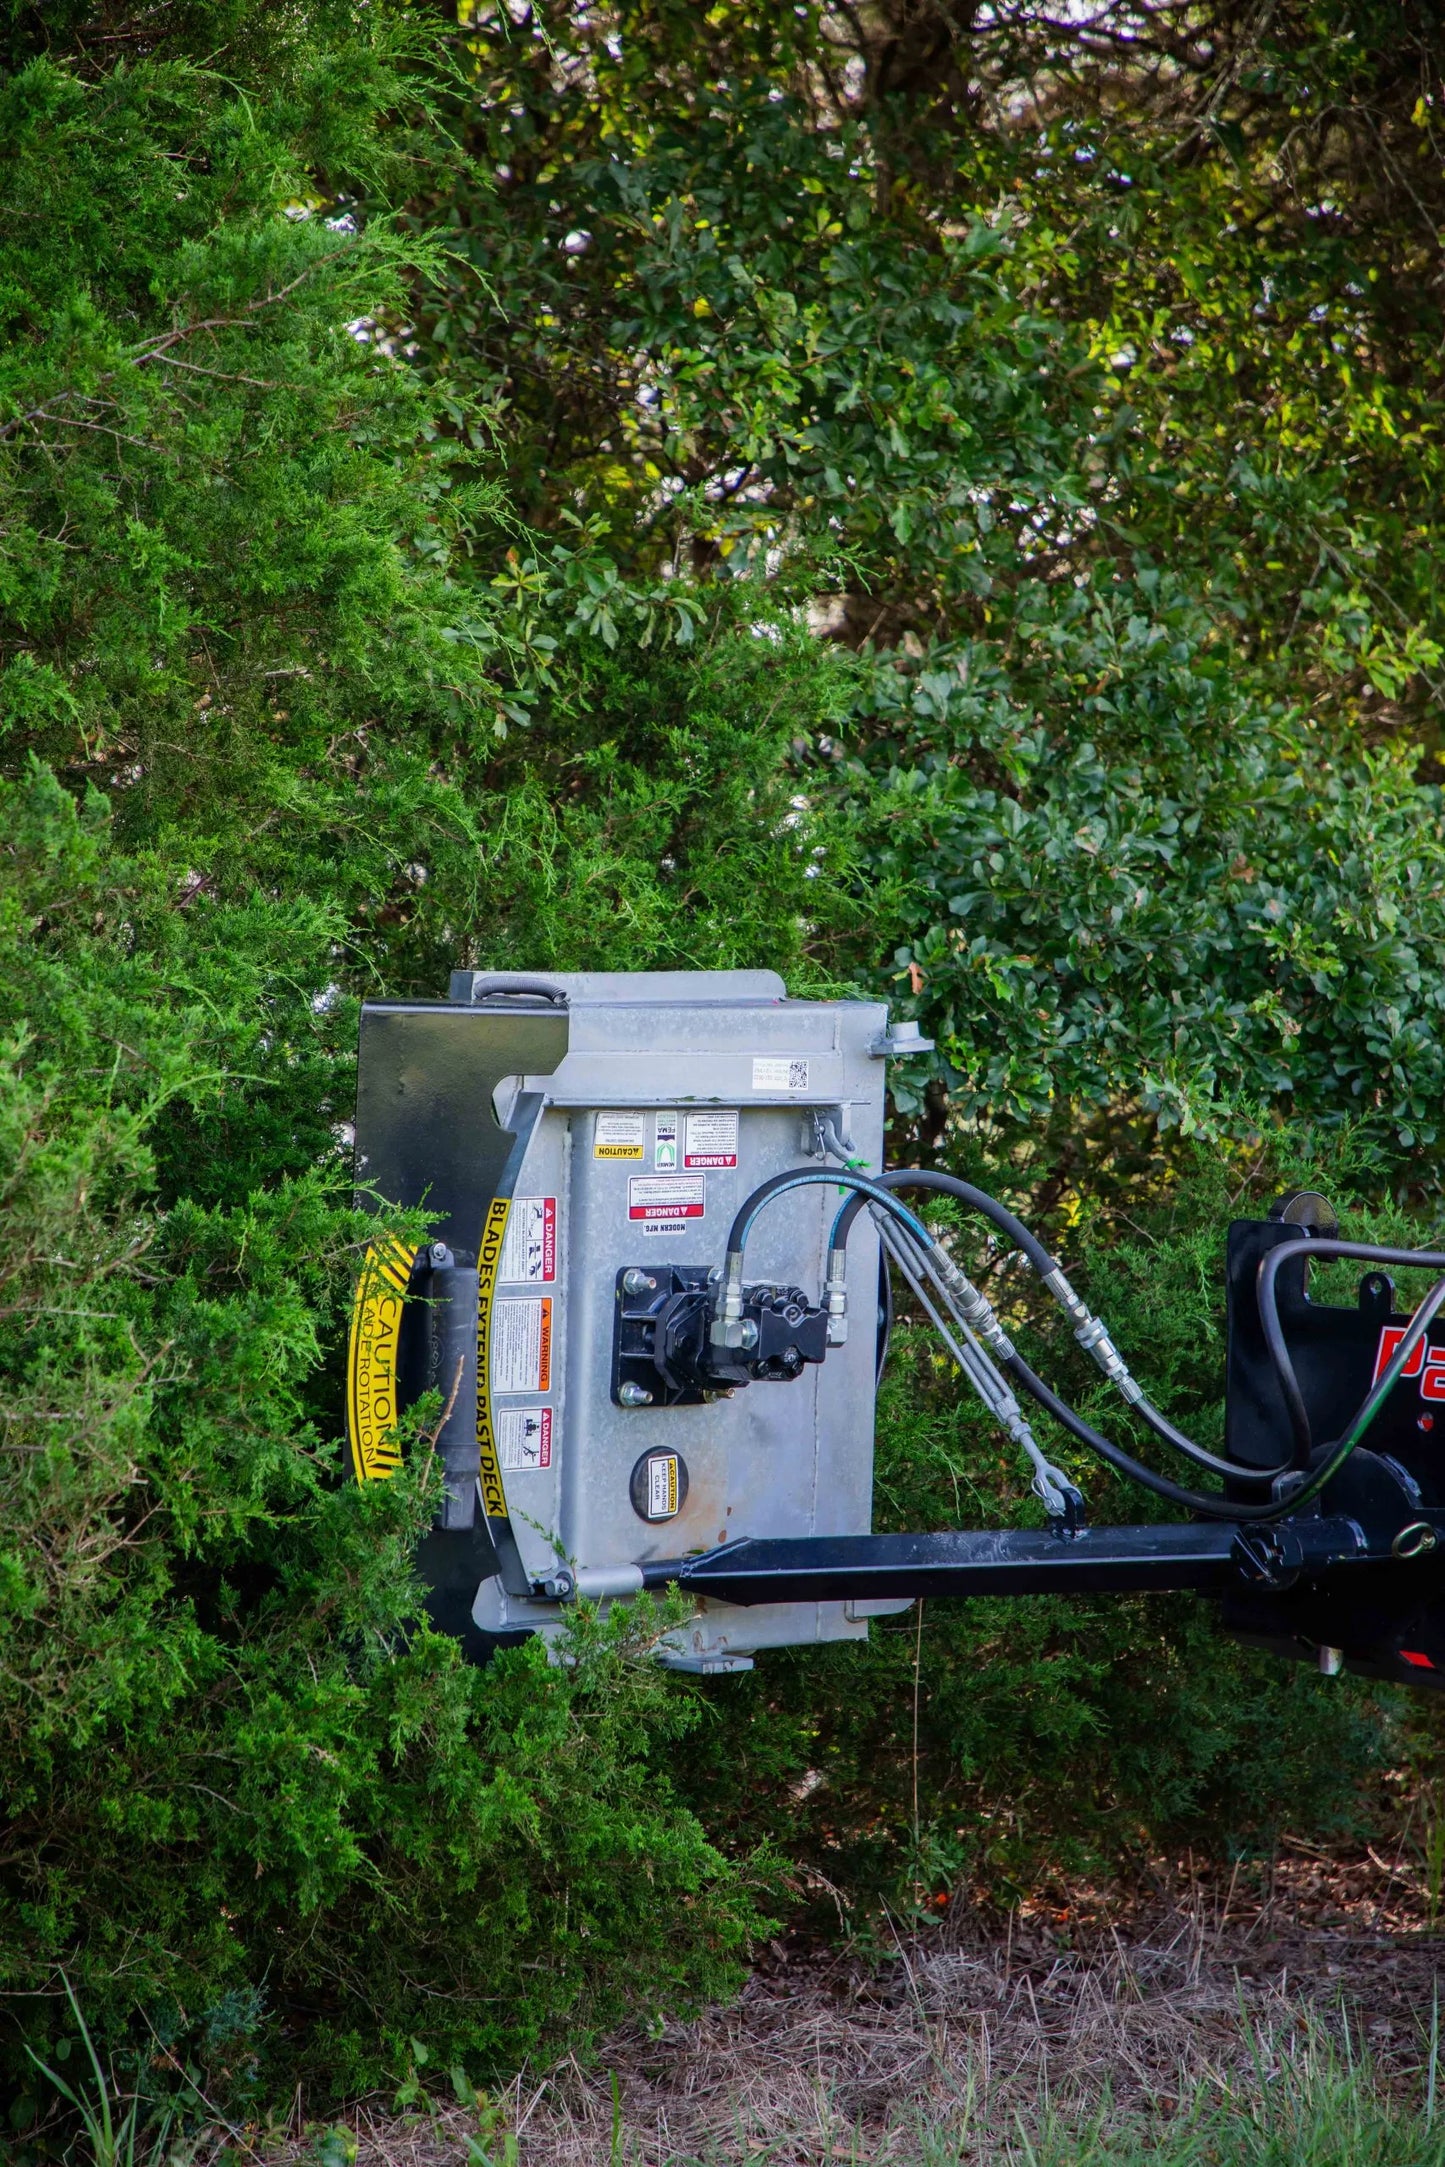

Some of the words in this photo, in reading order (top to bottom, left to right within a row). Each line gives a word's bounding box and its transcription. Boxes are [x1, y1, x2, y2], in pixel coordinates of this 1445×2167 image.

[690, 1157, 724, 1165] DANGER
[645, 1207, 679, 1216] DANGER
[479, 1202, 506, 1289] BLADES
[374, 1296, 397, 1446] CAUTION
[477, 1297, 488, 1388] EXTEND
[541, 1327, 549, 1381] WARNING
[359, 1358, 376, 1463] ROTATION
[476, 1396, 491, 1451] PAST
[480, 1456, 503, 1514] DECK
